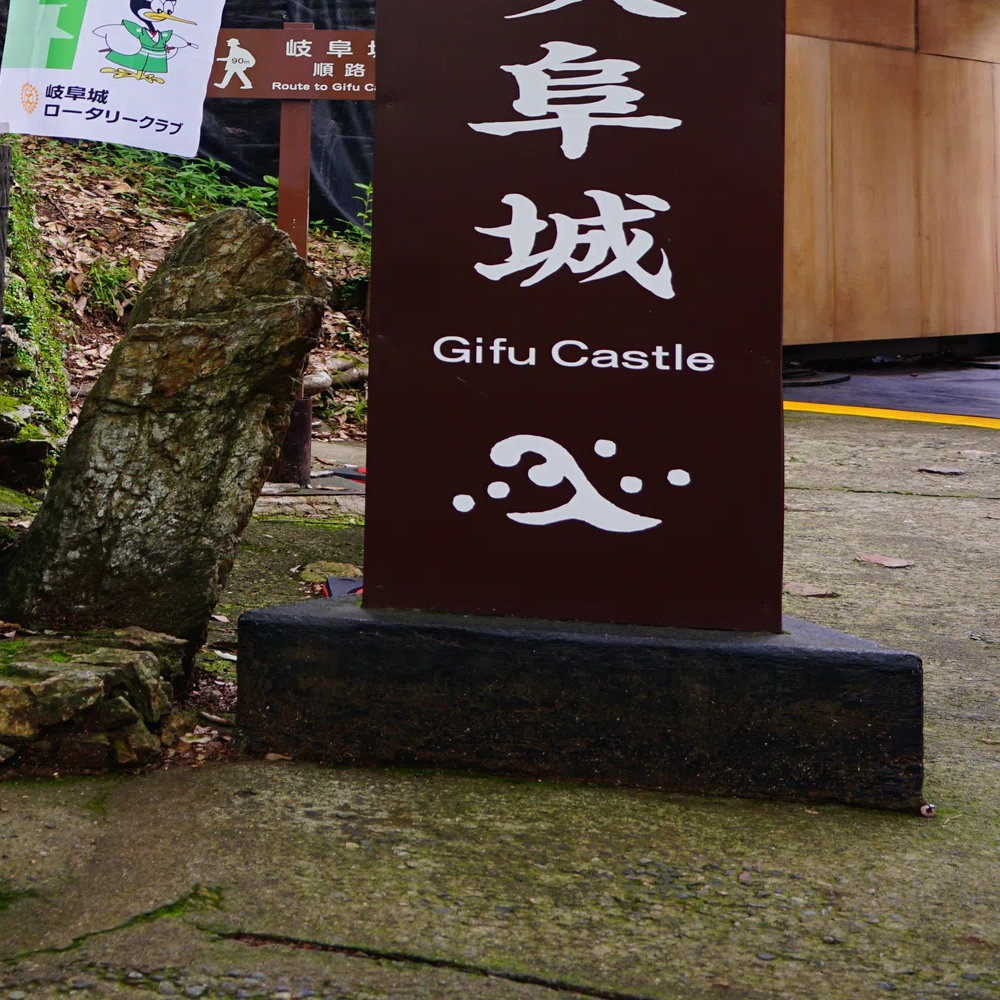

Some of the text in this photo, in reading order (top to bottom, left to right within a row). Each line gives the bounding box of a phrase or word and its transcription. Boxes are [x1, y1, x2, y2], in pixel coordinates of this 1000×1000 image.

[313, 62, 366, 78] 順路
[45, 84, 109, 105] 岐阜城
[272, 82, 310, 91] Route
[314, 82, 328, 91] to
[332, 82, 361, 92] Gifu
[44, 103, 184, 135] ロータリークラブ
[432, 335, 715, 372] Gifu Castle
